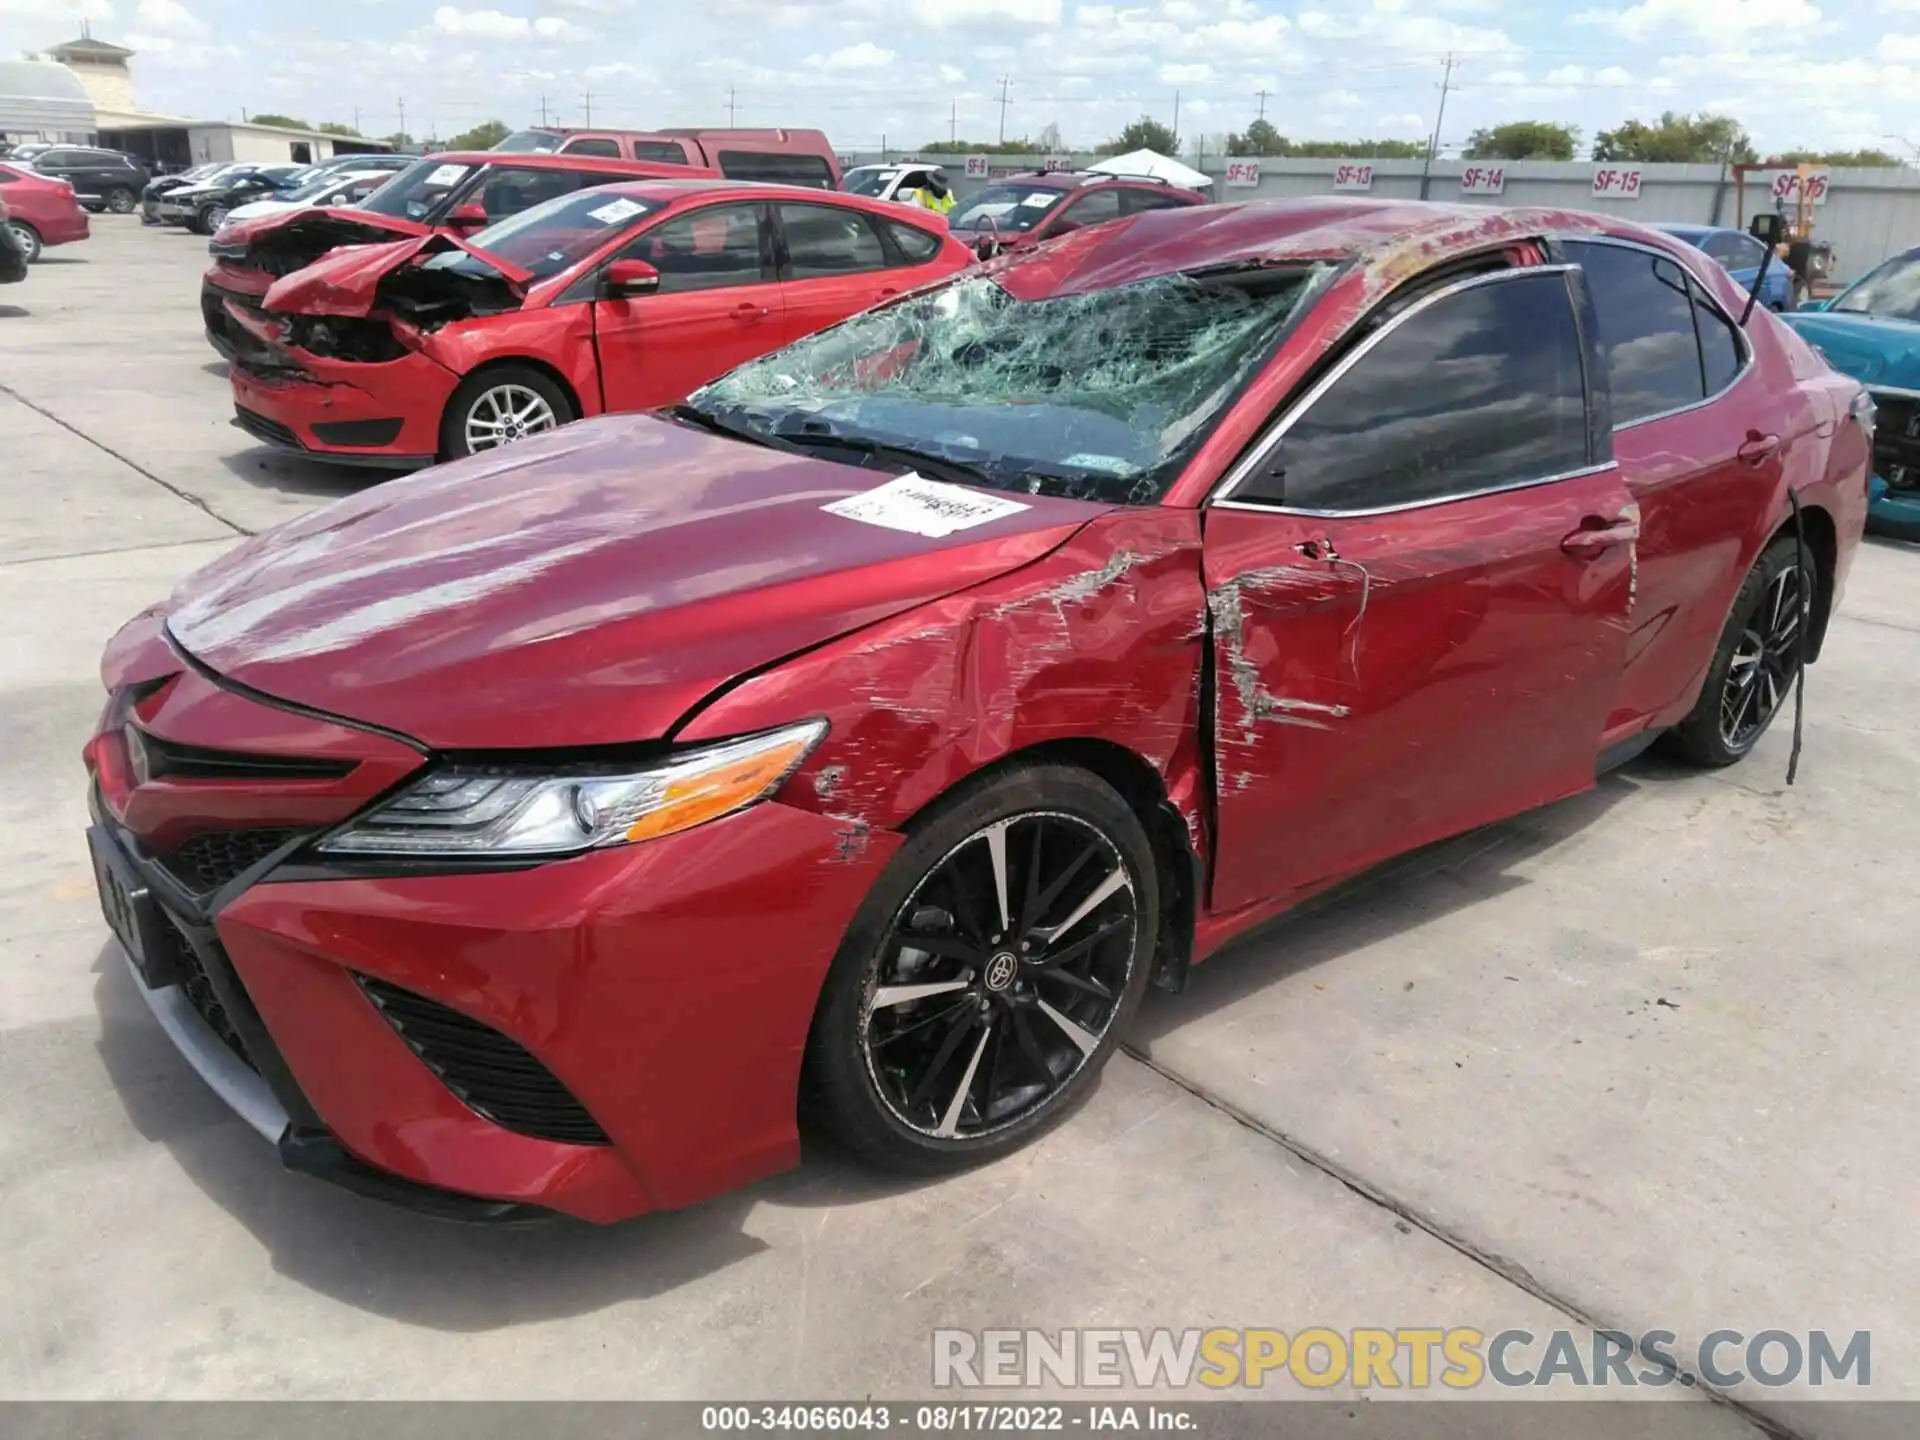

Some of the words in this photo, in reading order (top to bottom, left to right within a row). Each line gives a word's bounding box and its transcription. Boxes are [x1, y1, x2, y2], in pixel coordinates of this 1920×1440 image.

[1226, 164, 1258, 181] SF-12
[1336, 165, 1372, 185] SF-13
[1463, 168, 1503, 188] SF-14
[1594, 170, 1640, 191] SF-15
[1773, 174, 1828, 198] SF16
